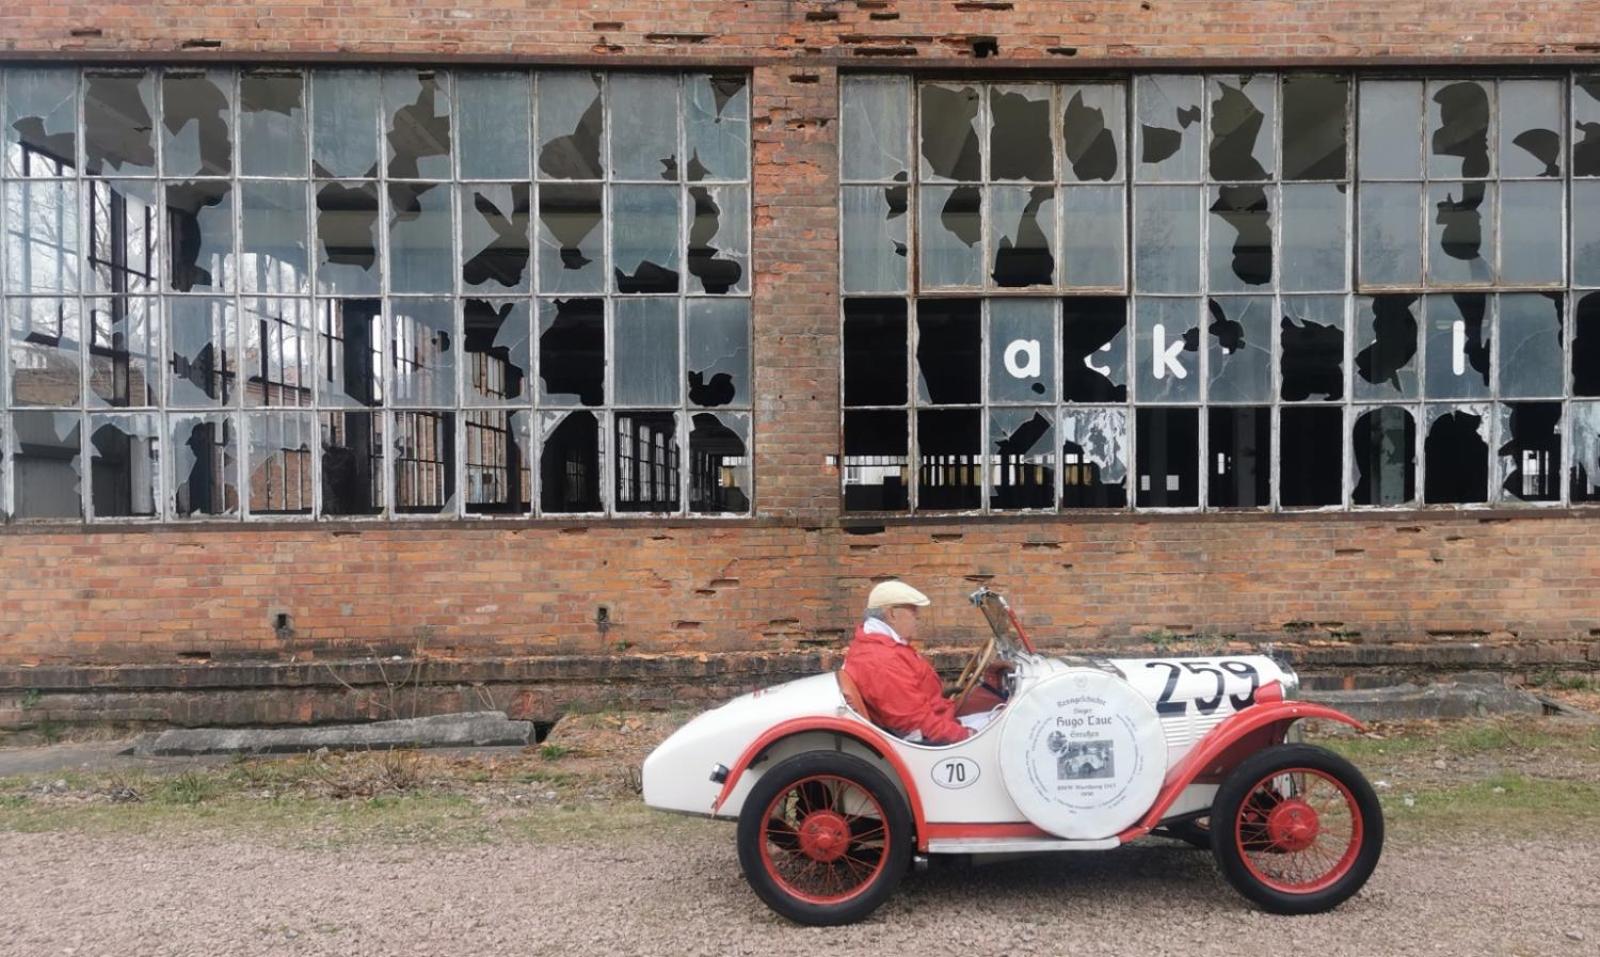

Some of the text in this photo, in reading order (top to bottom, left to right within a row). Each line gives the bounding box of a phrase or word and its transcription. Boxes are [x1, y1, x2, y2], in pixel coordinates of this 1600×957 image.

[1145, 661, 1259, 717] 259
[1056, 716, 1084, 729] Hugo
[946, 763, 965, 783] 70
